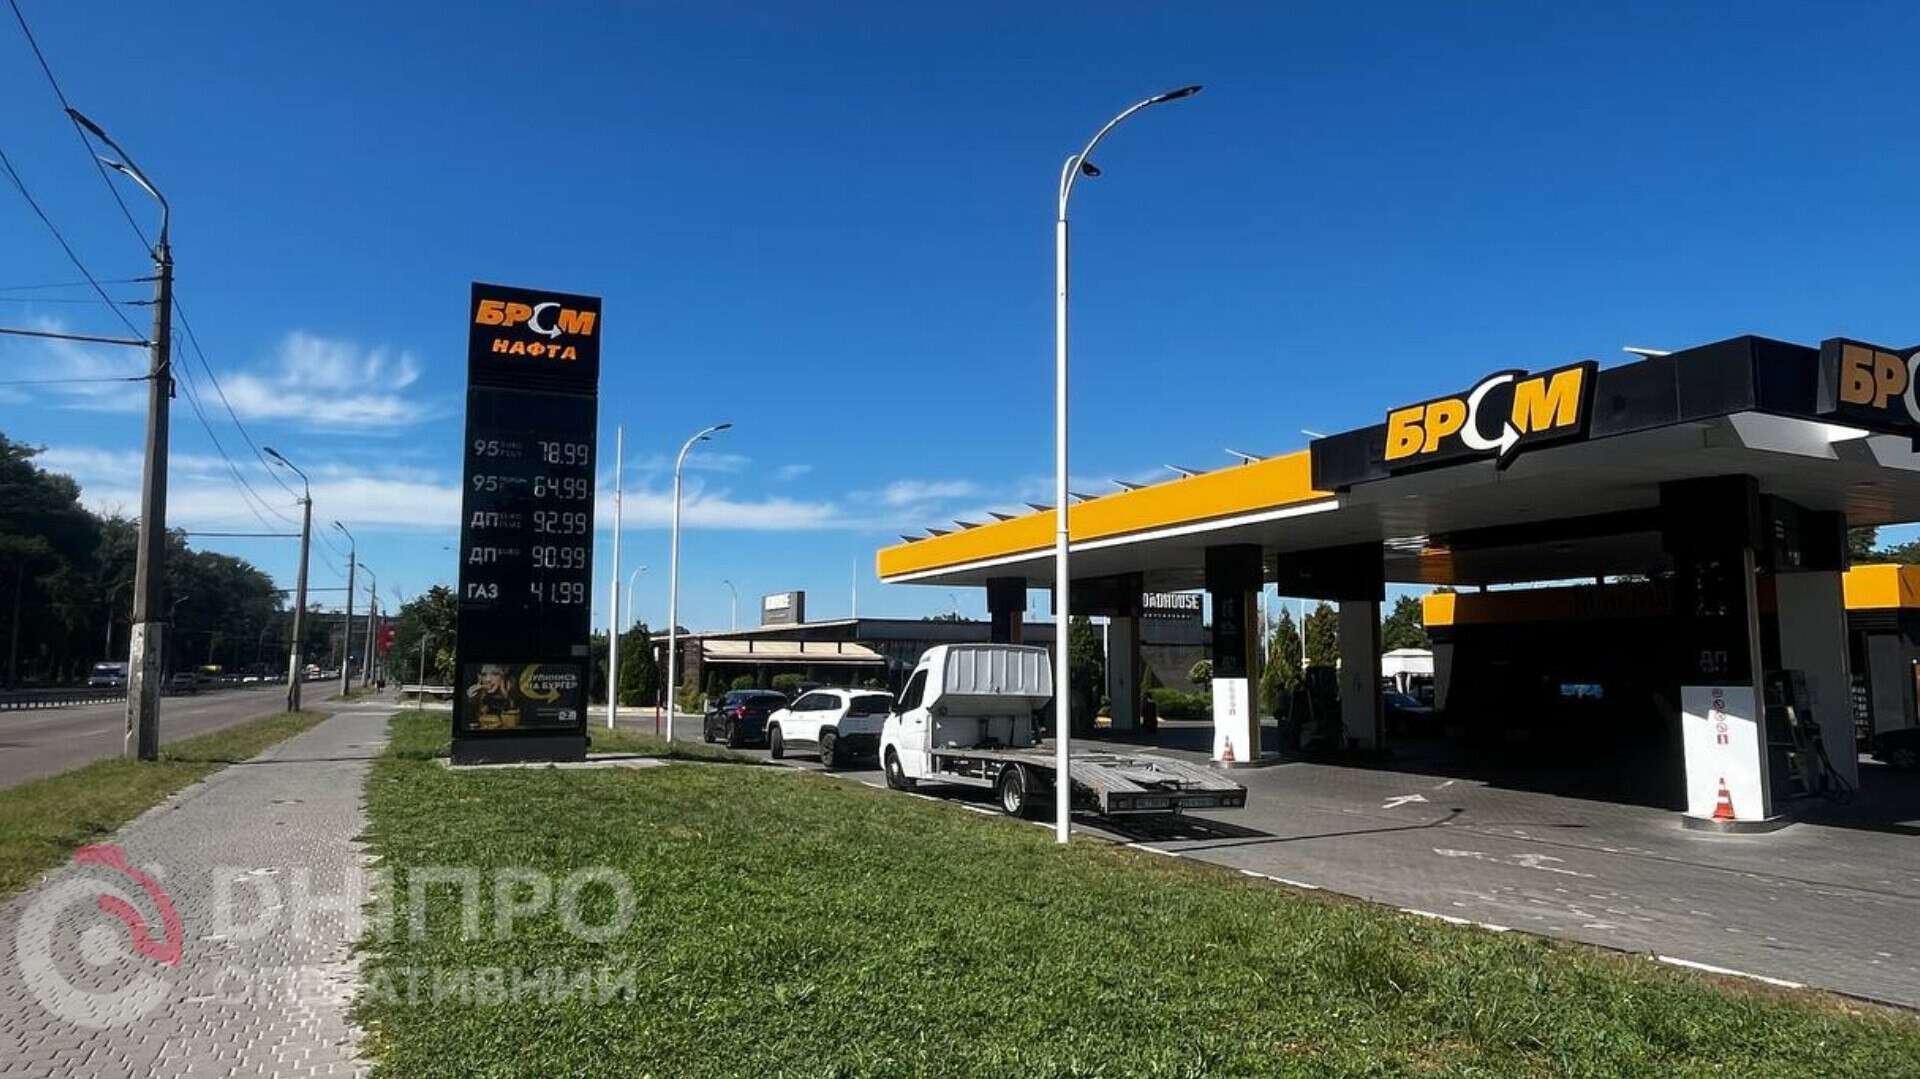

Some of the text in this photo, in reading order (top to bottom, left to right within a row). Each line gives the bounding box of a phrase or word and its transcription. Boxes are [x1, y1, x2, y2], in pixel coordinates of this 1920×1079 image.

[475, 299, 596, 339] БРСМ
[492, 338, 577, 360] НАФТА
[1384, 367, 1584, 461] БРСМ
[474, 440, 499, 456] 95
[538, 441, 589, 465] 78.99
[472, 475, 498, 492] 95
[534, 476, 587, 499] 64.99
[471, 511, 499, 529] ДП
[534, 510, 587, 534] 92.99
[469, 546, 497, 565] ДП
[532, 545, 585, 568] 90.99
[468, 582, 584, 604] ГАЗ 41.99
[1142, 592, 1200, 609] OADHOUSE
